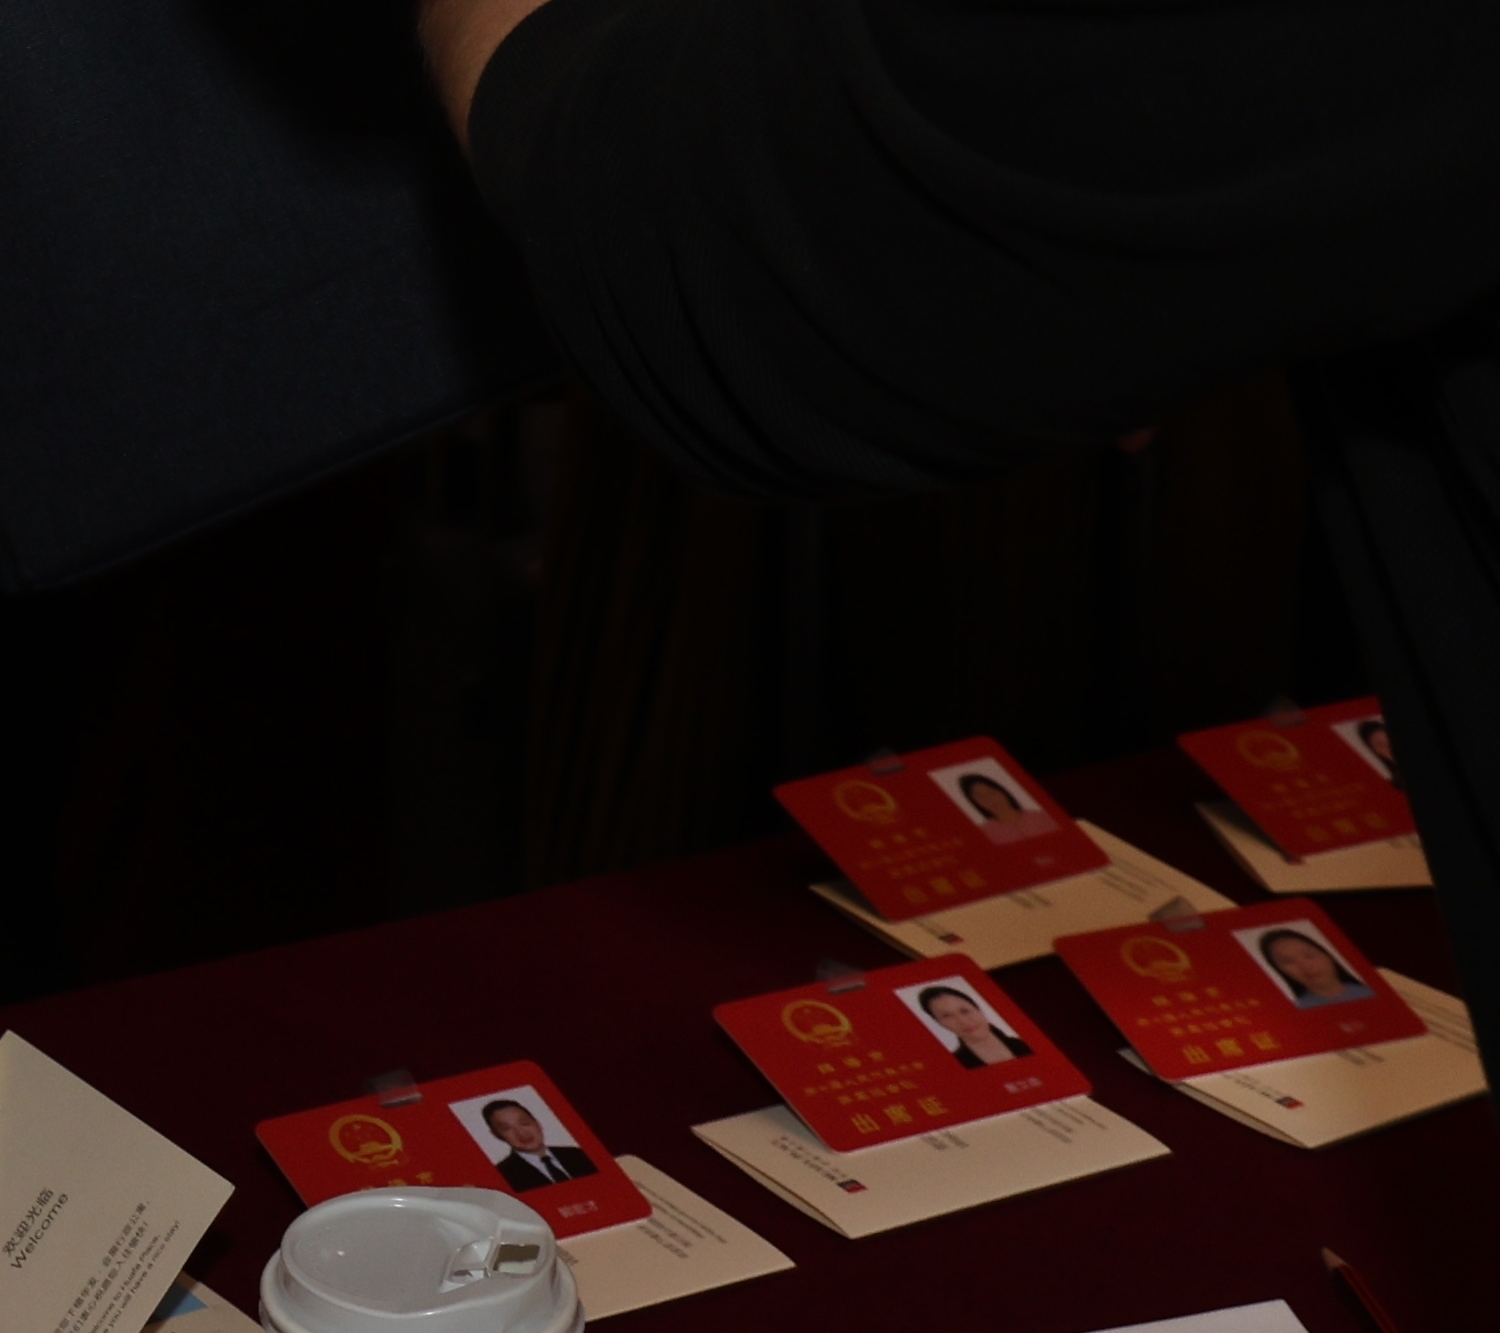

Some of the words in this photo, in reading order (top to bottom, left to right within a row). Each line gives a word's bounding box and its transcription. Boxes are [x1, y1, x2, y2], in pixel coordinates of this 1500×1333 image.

[850, 1095, 950, 1135] 出席证
[2, 1187, 55, 1255] 欢迎光临
[9, 1192, 69, 1270] Welcome
[90, 1301, 116, 1333] elcome
